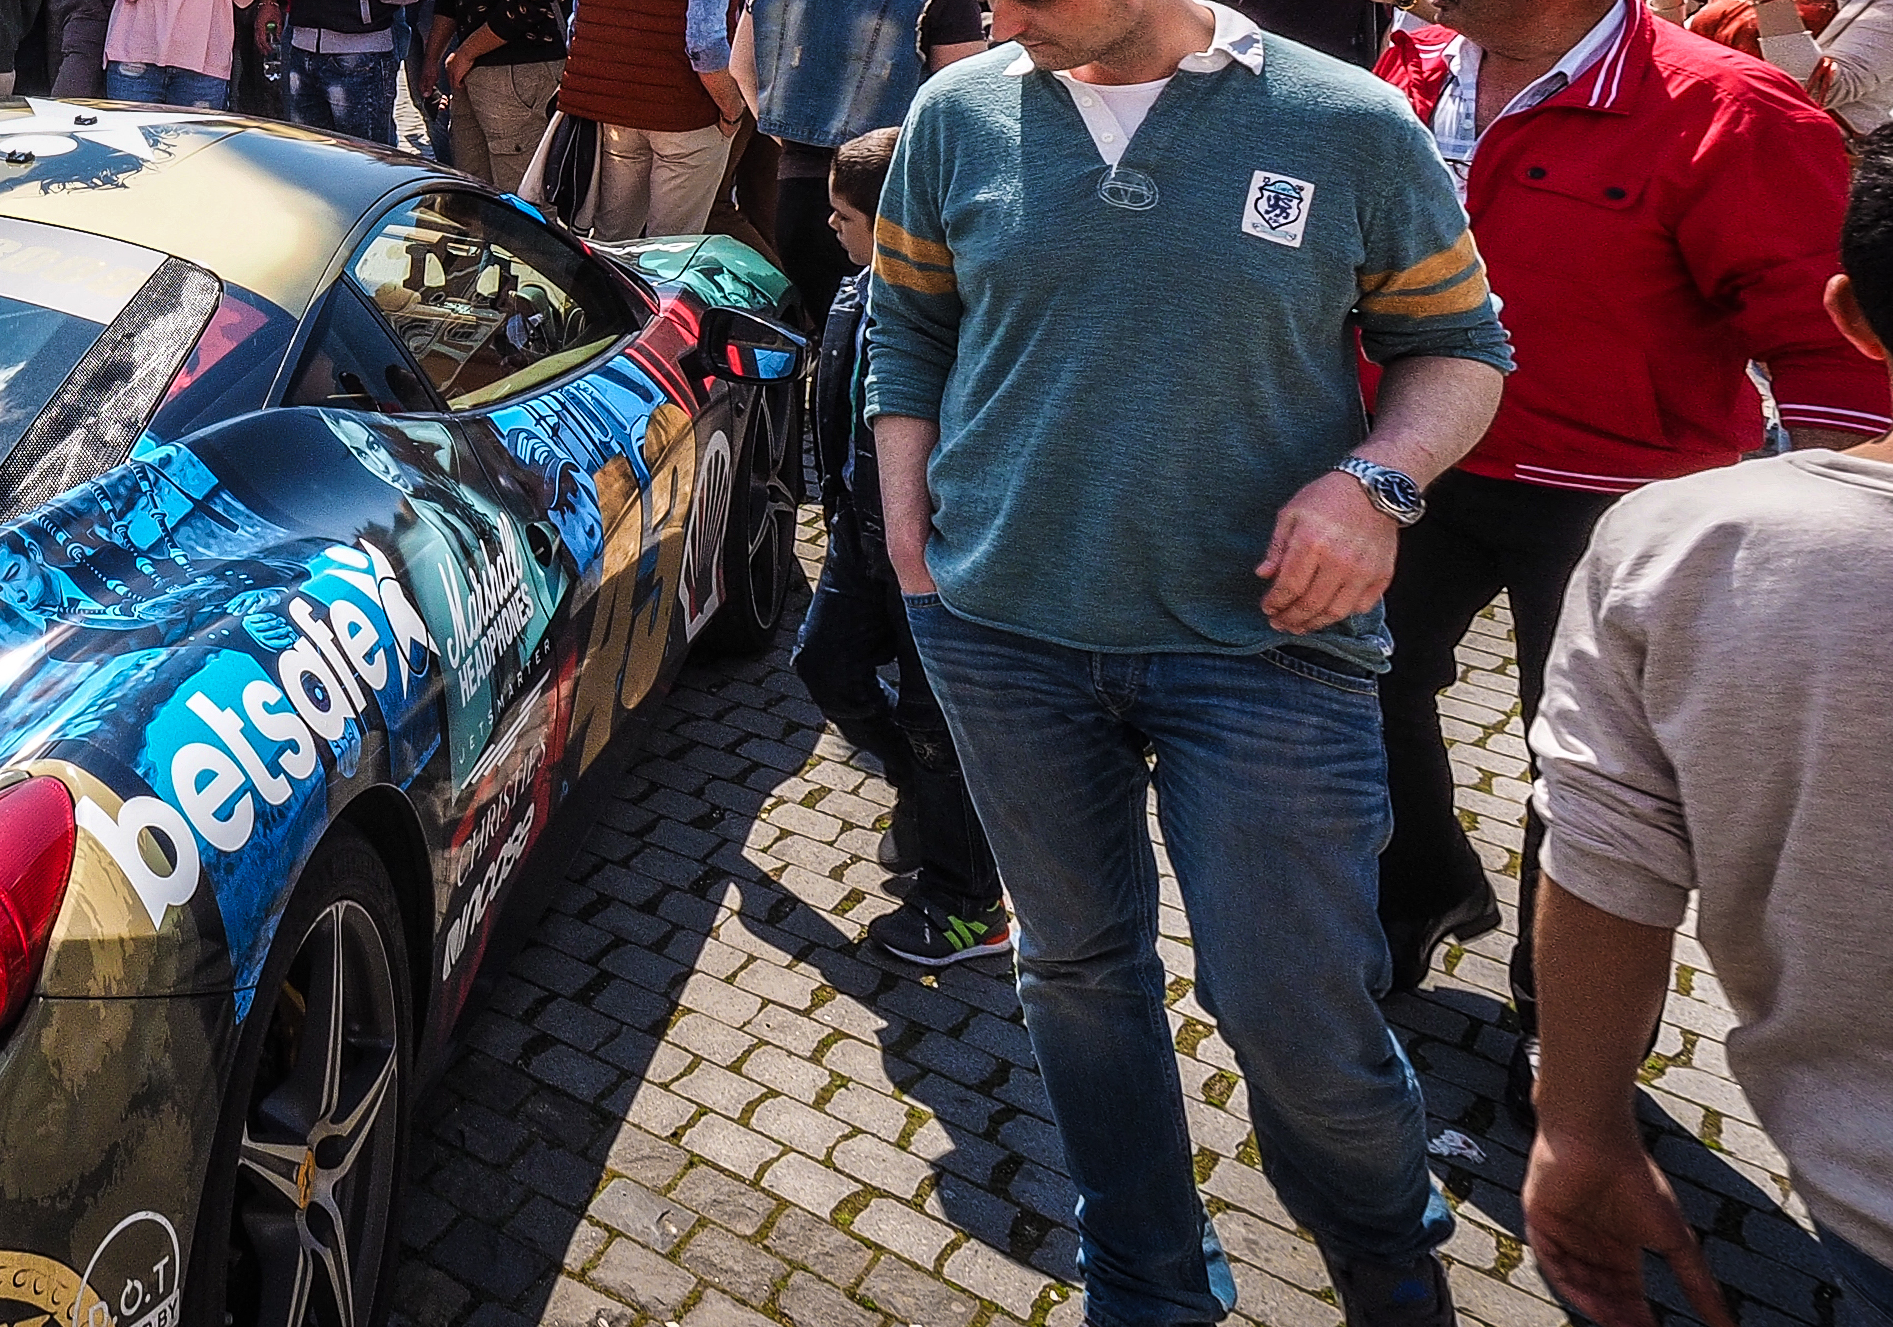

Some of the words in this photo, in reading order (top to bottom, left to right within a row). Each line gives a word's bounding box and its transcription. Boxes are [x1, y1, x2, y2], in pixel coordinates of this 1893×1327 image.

[438, 511, 524, 670] Marshall
[457, 582, 535, 709] HEADPHONES
[74, 596, 388, 932] betsafe
